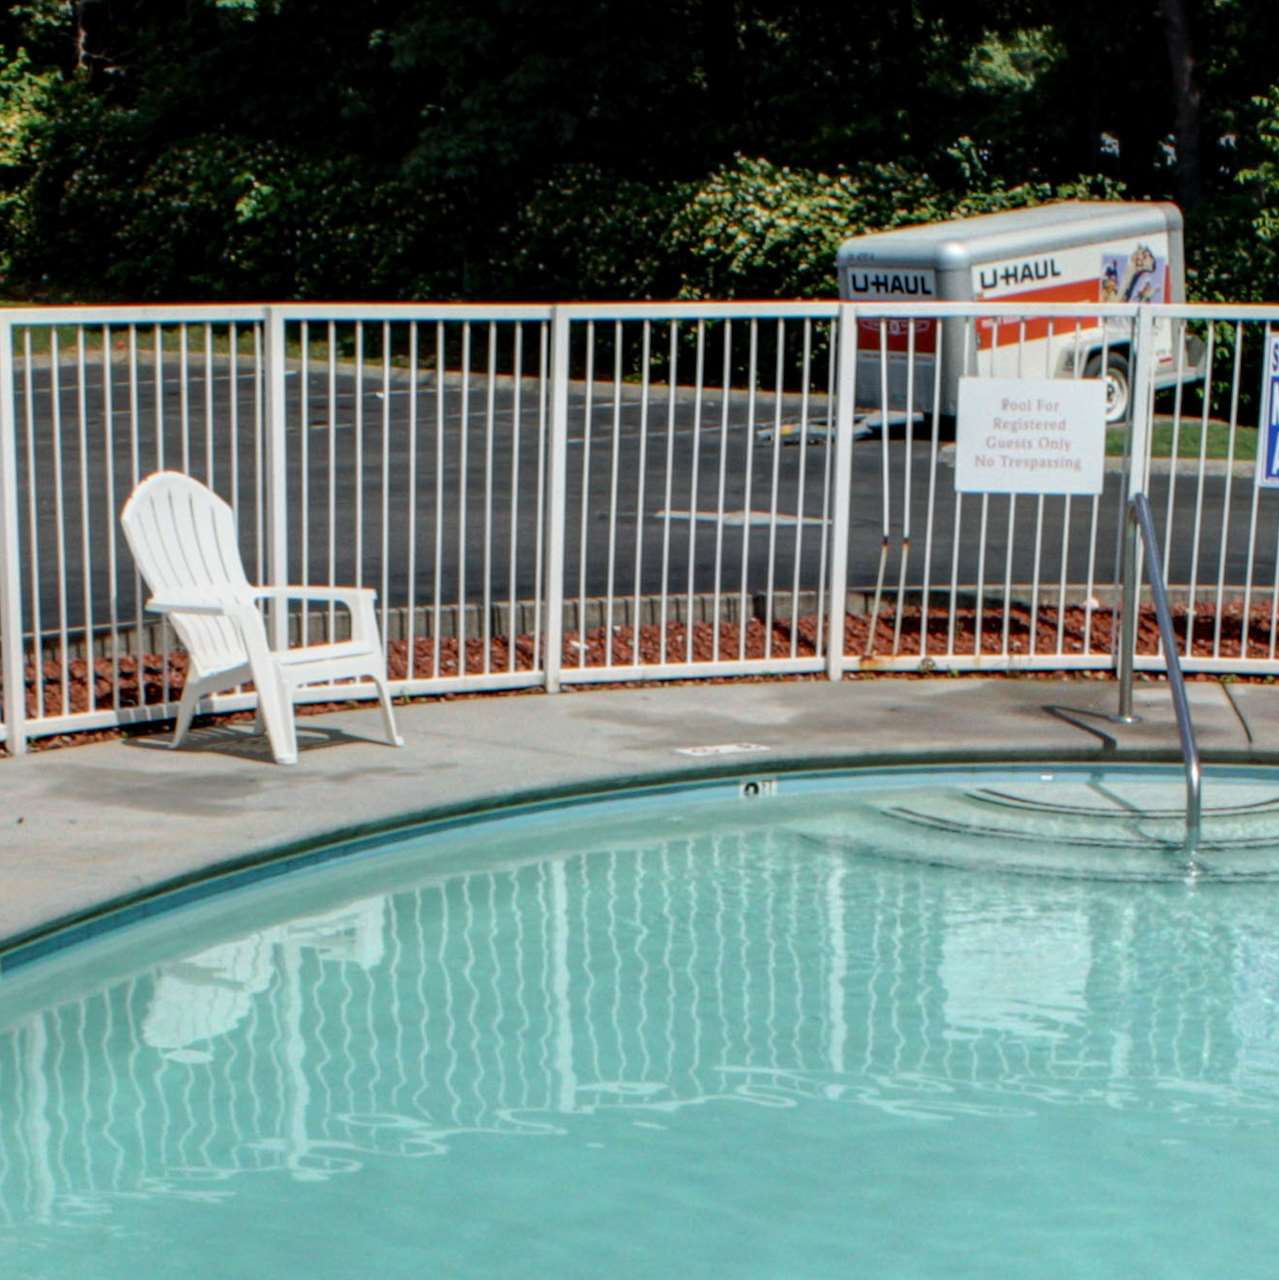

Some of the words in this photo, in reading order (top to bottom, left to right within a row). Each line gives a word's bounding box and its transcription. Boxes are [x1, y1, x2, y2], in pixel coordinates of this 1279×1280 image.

[980, 258, 1062, 290] U-HAUL
[851, 273, 932, 295] U-HAUL
[1001, 398, 1032, 412] Pool
[1038, 398, 1060, 412] For
[993, 417, 1067, 433] Registered
[985, 436, 1033, 450] Guests
[1038, 436, 1072, 452] Only
[974, 455, 995, 468] No
[1001, 455, 1082, 472] Trespassing
